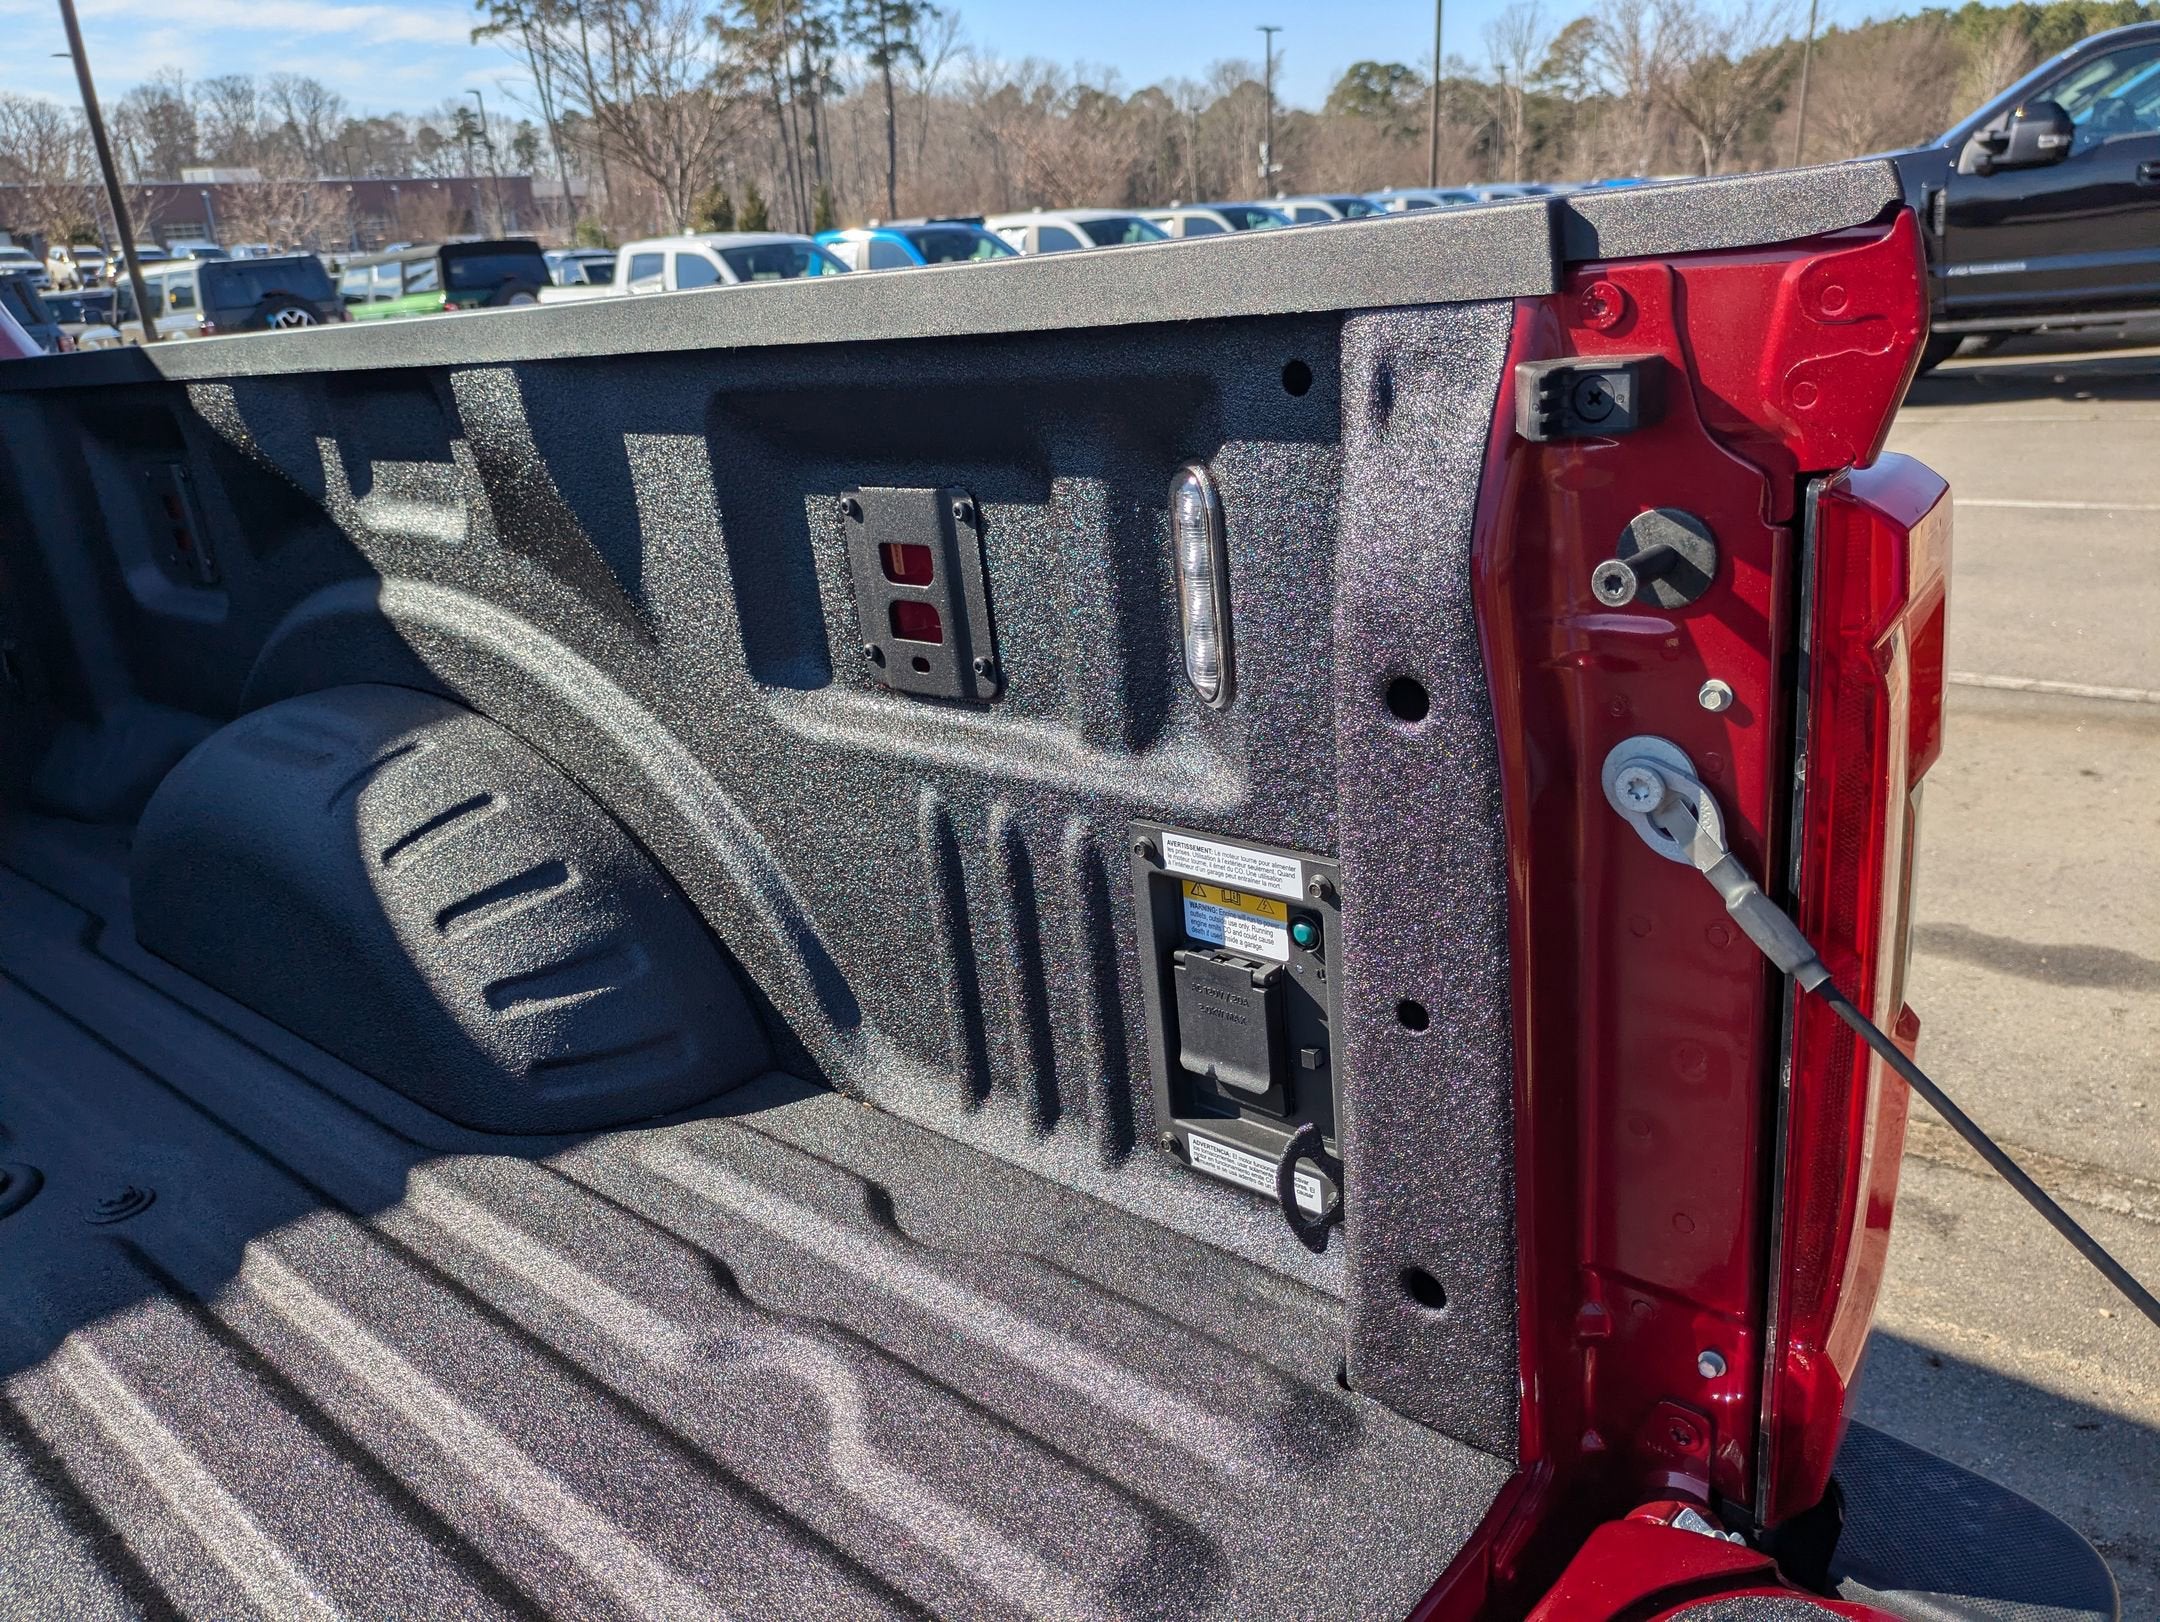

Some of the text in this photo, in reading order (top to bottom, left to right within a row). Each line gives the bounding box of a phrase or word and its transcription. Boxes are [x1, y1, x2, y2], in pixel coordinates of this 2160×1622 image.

[1167, 840, 1214, 854] AVERTISSEMENT:
[1222, 852, 1240, 860] moteur
[1241, 856, 1258, 864] tourne
[1272, 862, 1296, 872] alimenter
[1192, 852, 1216, 862] Utilisation
[1247, 864, 1277, 875] seulement.
[1277, 869, 1296, 879] Quand
[1207, 868, 1224, 878] garage
[1225, 872, 1237, 880] peut
[1246, 870, 1257, 878] Une
[1258, 872, 1283, 883] utilisation
[1189, 901, 1218, 914] WARNING:
[1219, 907, 1236, 918] Engine
[1191, 919, 1207, 928] engine
[1233, 929, 1242, 937] and
[1243, 932, 1258, 941] could
[1258, 936, 1275, 945] cause
[1228, 920, 1237, 928] use
[1252, 924, 1274, 938] Running
[1193, 1139, 1231, 1158] ADVERTENCIA:
[1238, 1156, 1252, 1165] motor
[1266, 1177, 1274, 1185] CO
